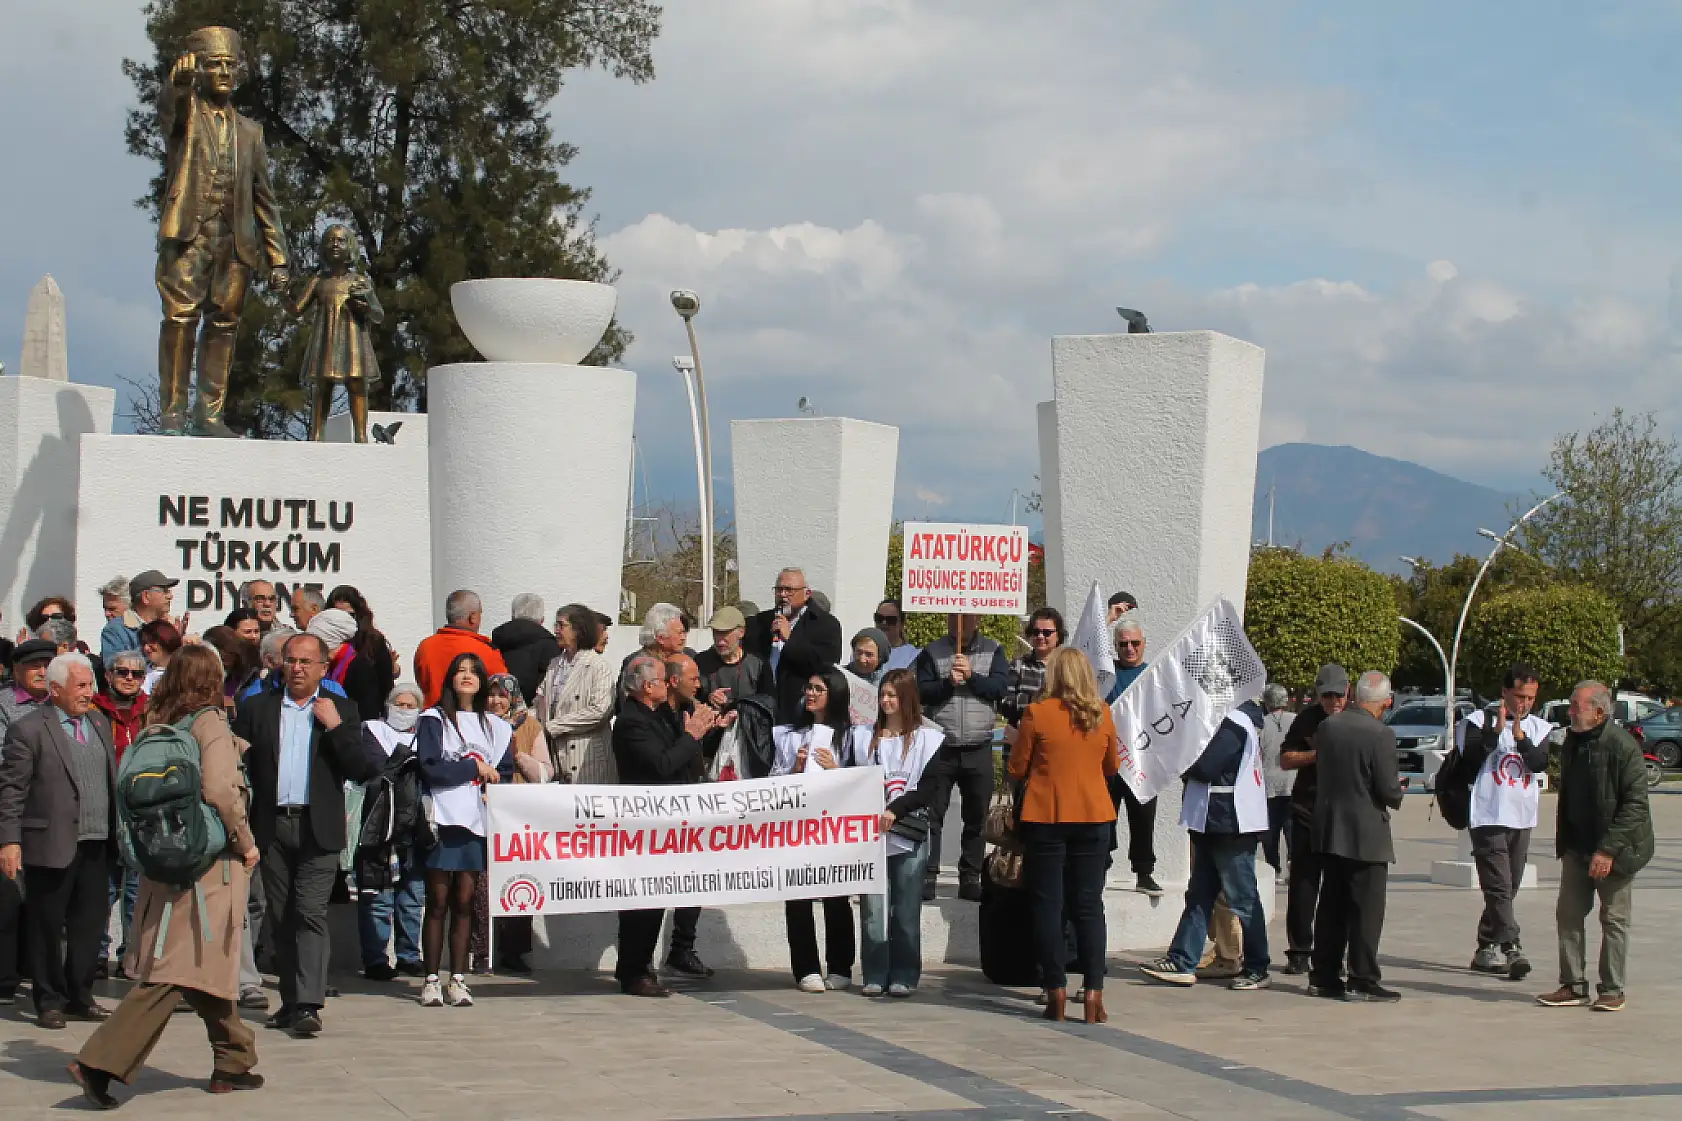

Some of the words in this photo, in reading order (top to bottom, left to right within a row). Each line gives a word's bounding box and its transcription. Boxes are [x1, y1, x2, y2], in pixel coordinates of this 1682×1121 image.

[159, 494, 210, 526] NE
[220, 497, 354, 532] MUTLU
[176, 531, 341, 573] TÜRKÜM
[909, 528, 1023, 570] ATATÜRKÇÜ
[187, 571, 324, 612] DİYN
[908, 564, 967, 595] DÜŞÜNCE
[970, 568, 1023, 593] DERNEĞİ
[911, 595, 967, 607] FETHİYE
[574, 794, 606, 820] NE
[607, 790, 692, 818] TARİKAT
[698, 793, 727, 815] NE
[731, 782, 808, 819] ŞERİAT:
[493, 823, 552, 862] LAİK
[555, 822, 645, 860] EĞİTİM
[648, 820, 705, 855] LAİK
[709, 809, 881, 852] CUMHURİYET!
[549, 876, 602, 901] TÜRKİYE
[605, 877, 639, 899] HALK
[641, 868, 722, 895] TEMSİLCİLERİ
[725, 865, 774, 892] MECLİSİ
[785, 858, 876, 887] MUĞLA/FETHİYE
